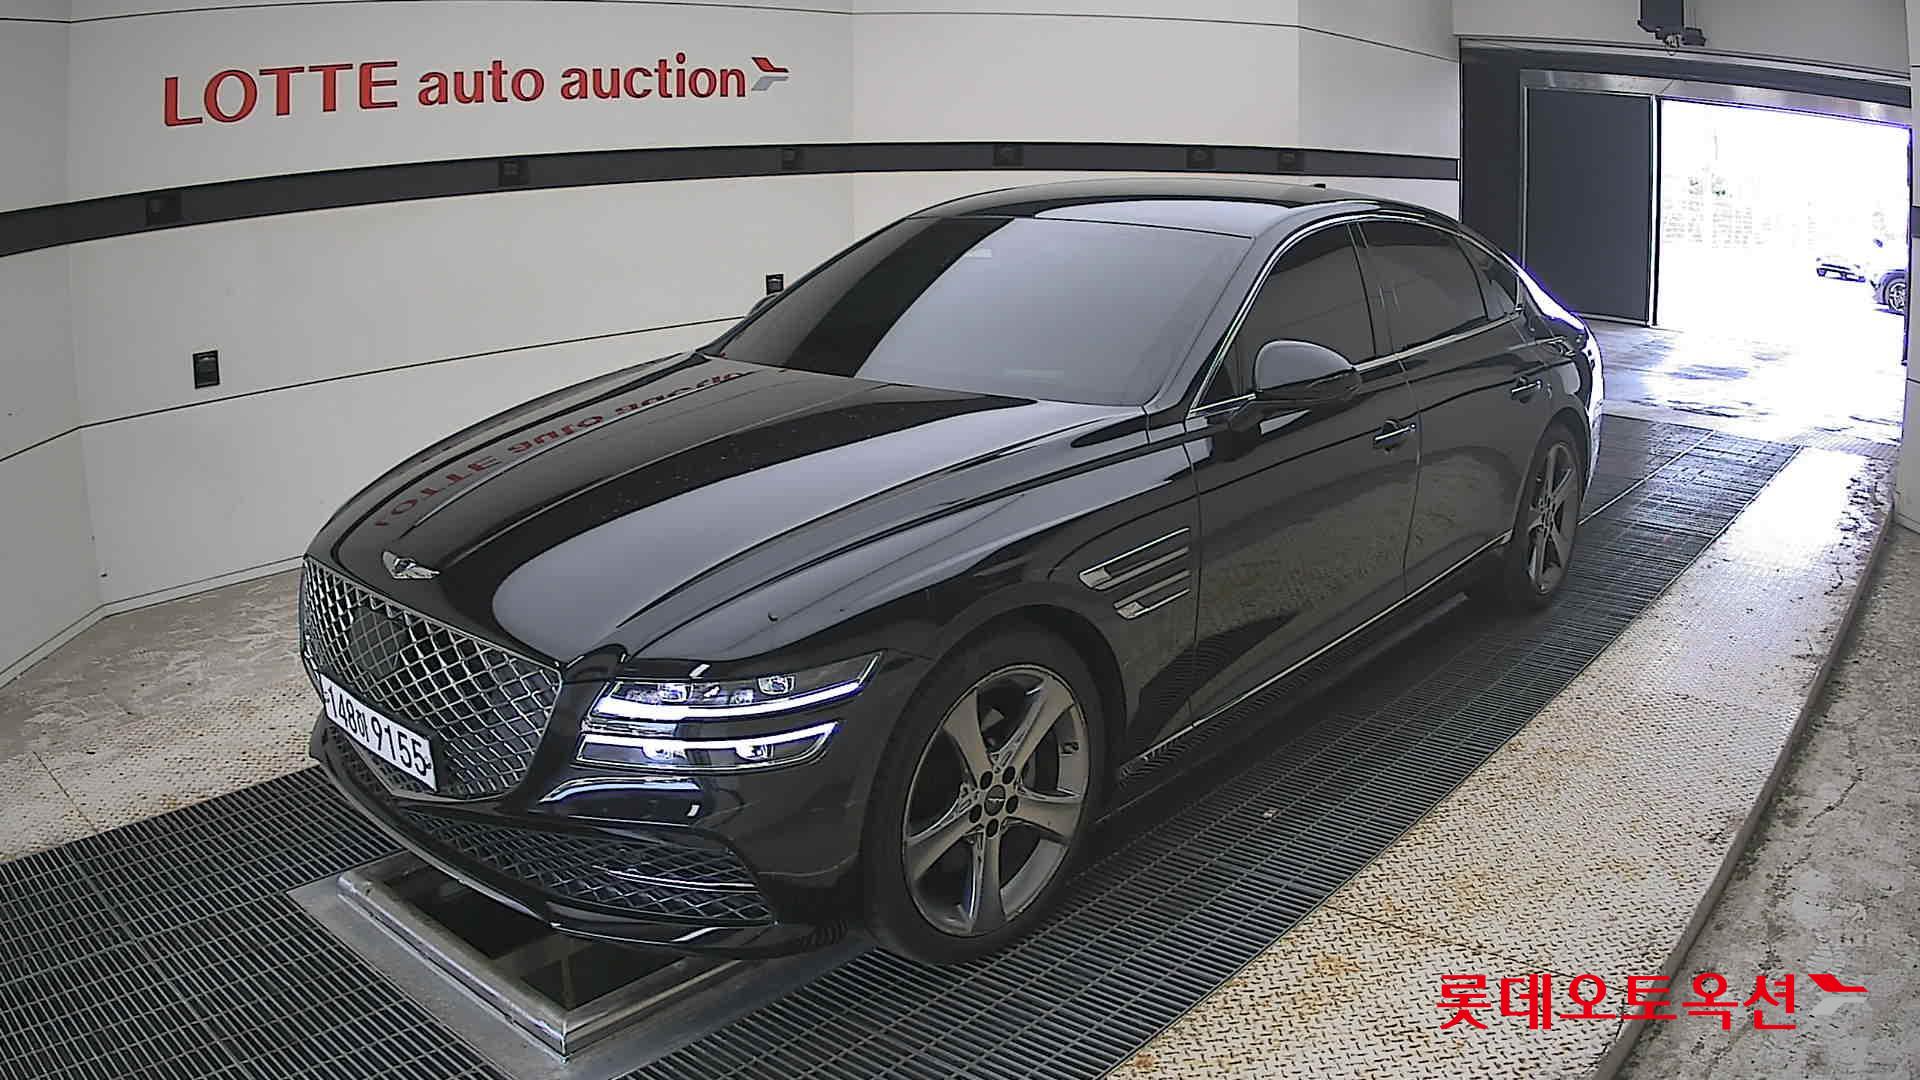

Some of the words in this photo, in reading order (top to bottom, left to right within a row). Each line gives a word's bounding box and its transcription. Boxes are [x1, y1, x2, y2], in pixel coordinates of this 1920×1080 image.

[164, 61, 398, 127] LOTTE
[417, 60, 545, 106] auto
[561, 52, 747, 99] auction
[371, 716, 428, 776] 9155
